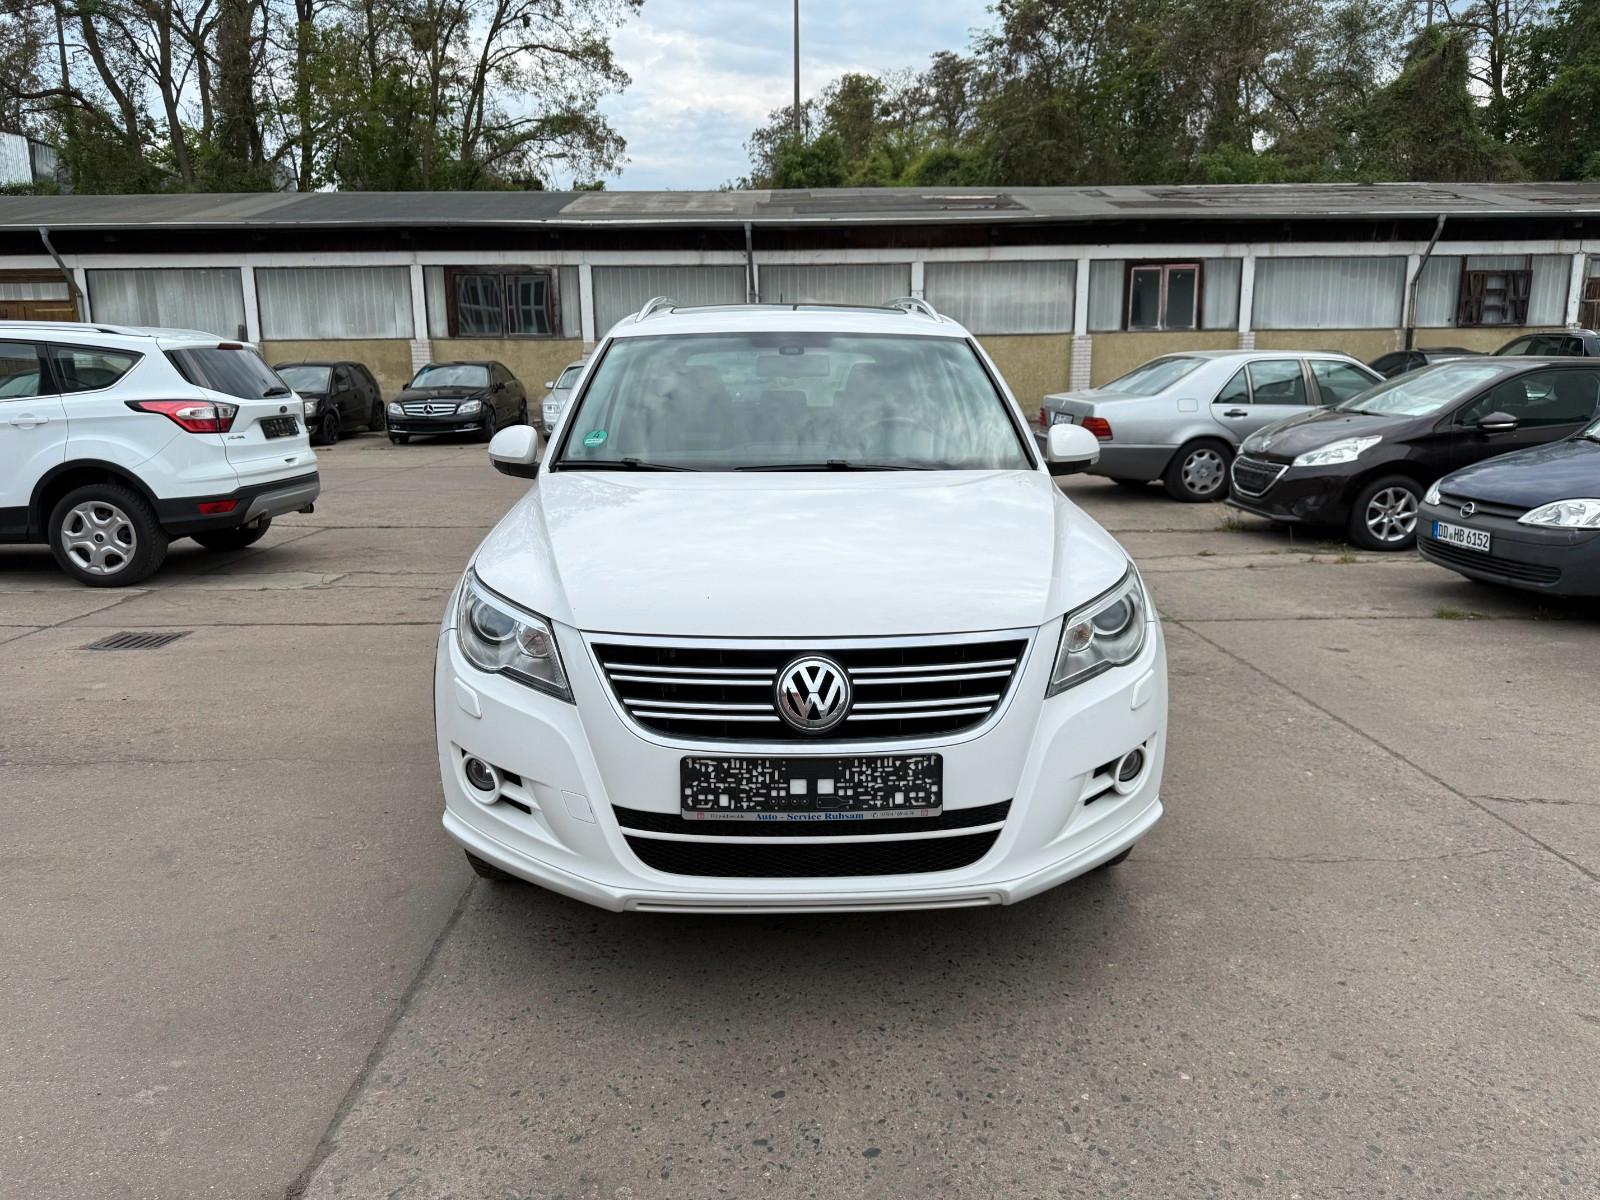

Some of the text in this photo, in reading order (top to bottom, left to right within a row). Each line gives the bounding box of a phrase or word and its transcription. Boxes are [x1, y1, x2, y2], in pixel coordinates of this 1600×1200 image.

[592, 430, 600, 438] 4
[1438, 524, 1489, 549] DD HB 6152
[779, 658, 849, 729] VW
[755, 813, 778, 821] Auto
[786, 812, 822, 821] Service
[824, 811, 865, 820] Ruhsam
